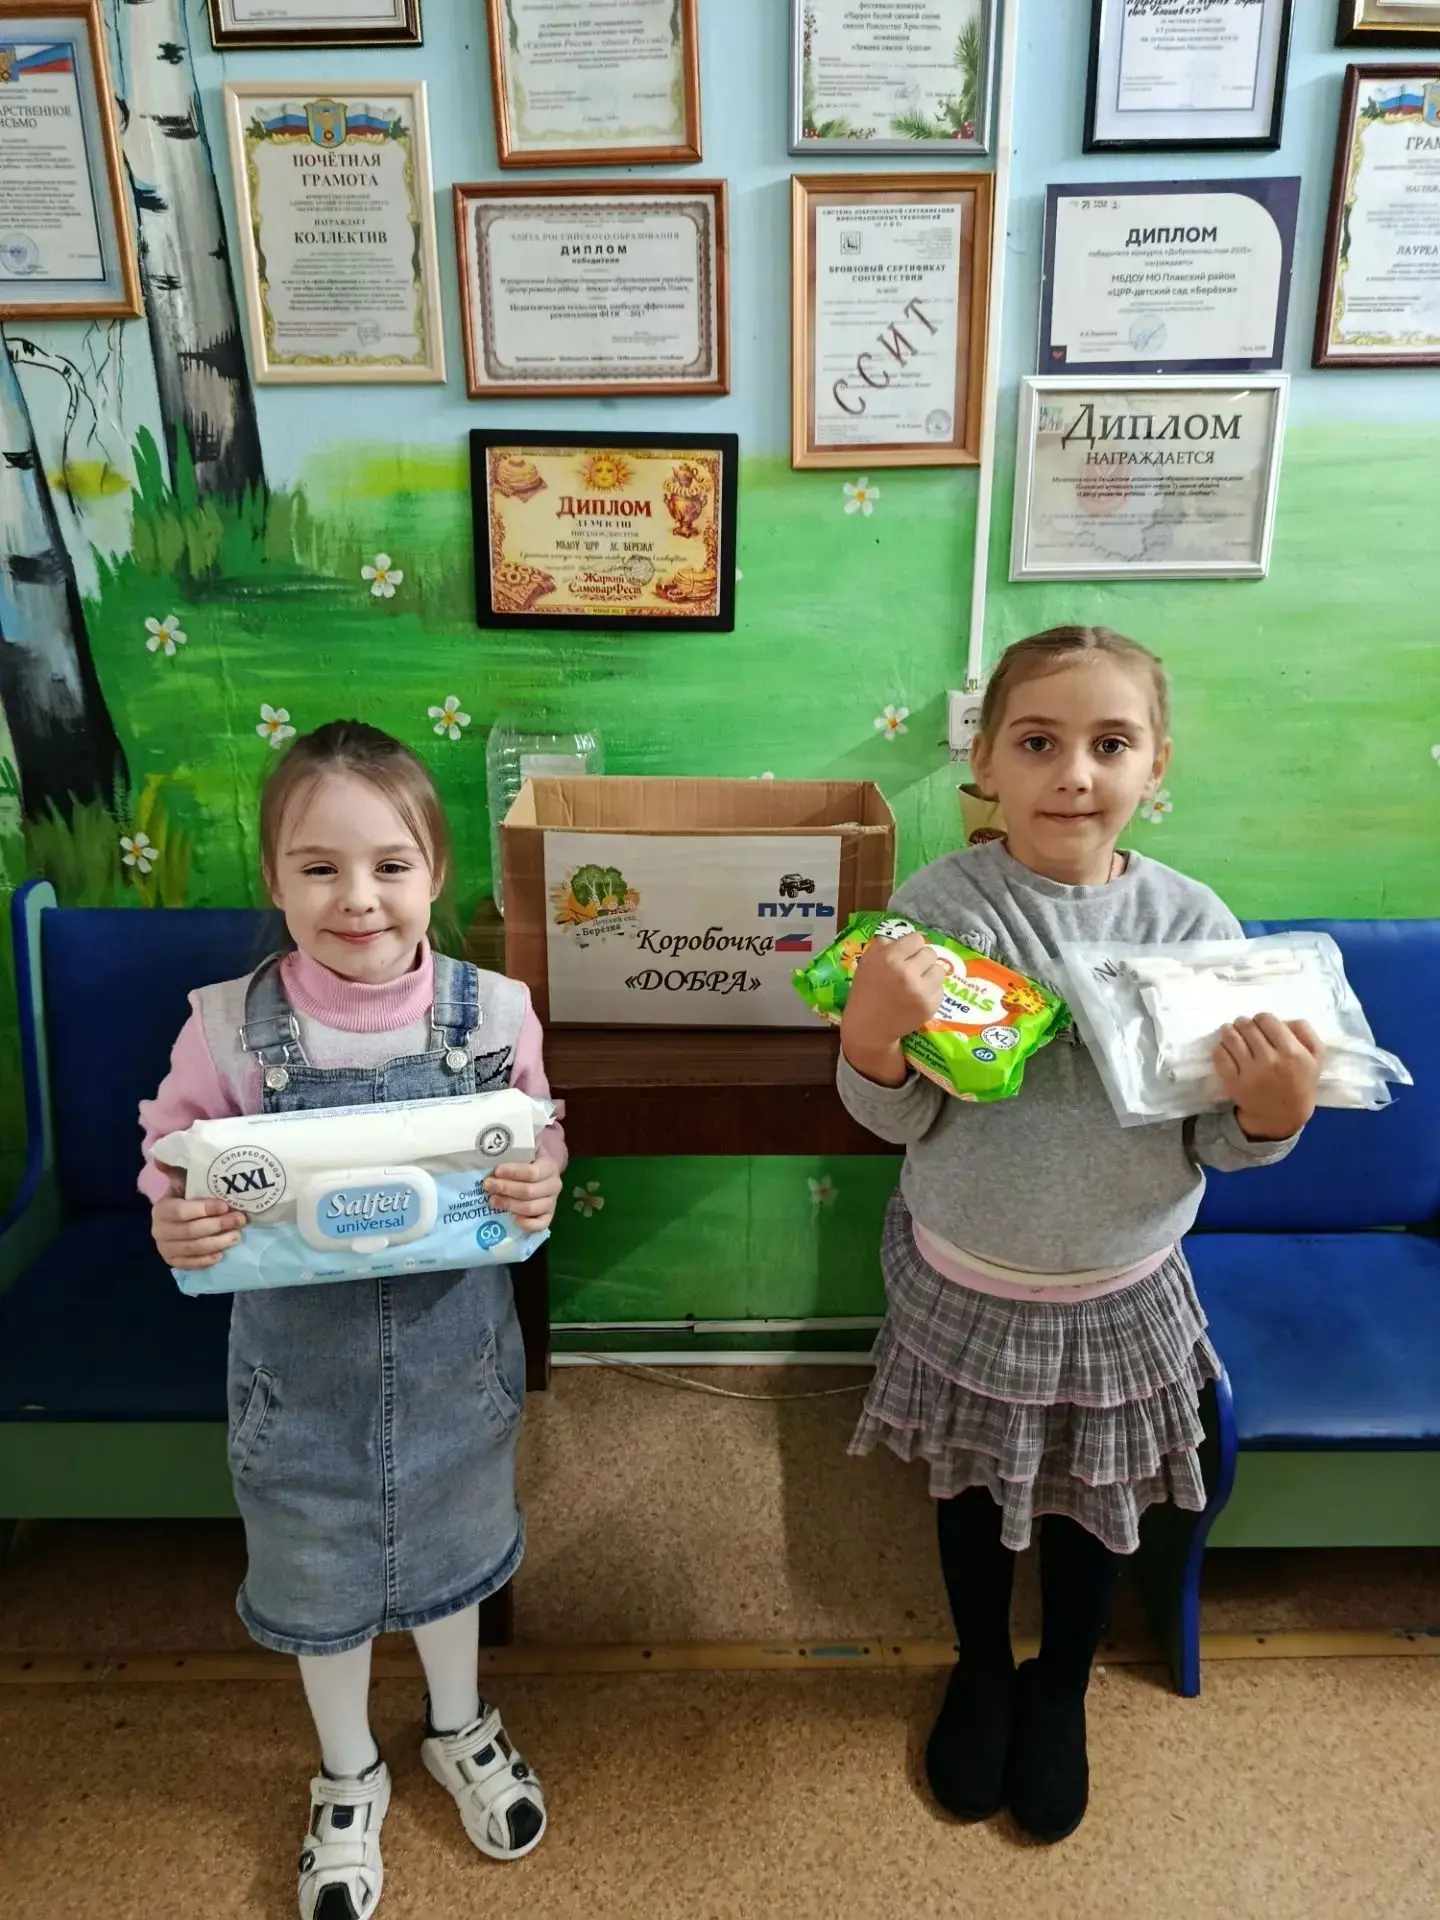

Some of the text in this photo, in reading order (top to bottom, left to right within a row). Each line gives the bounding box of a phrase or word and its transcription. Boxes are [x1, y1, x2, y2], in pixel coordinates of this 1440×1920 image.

[292, 152, 381, 168] ПОЧЁТНАЯ
[301, 173, 379, 187] ГРАМОТА
[294, 231, 388, 244] КОЛЛЕКТИВ
[1125, 226, 1218, 247] ДИПЛОМ
[560, 244, 628, 257] ДИПЛОМ
[1086, 450, 1215, 467] НАГРАЖДАЕТСЯ
[757, 901, 835, 918] ПУТЬ
[636, 926, 775, 958] Коробочка
[624, 968, 762, 994] «ДОБРА»
[975, 1049, 994, 1060] 60
[219, 1167, 276, 1195] XXL
[326, 1188, 413, 1221] Salfeti
[336, 1216, 406, 1235] universal
[480, 1222, 502, 1241] 60
